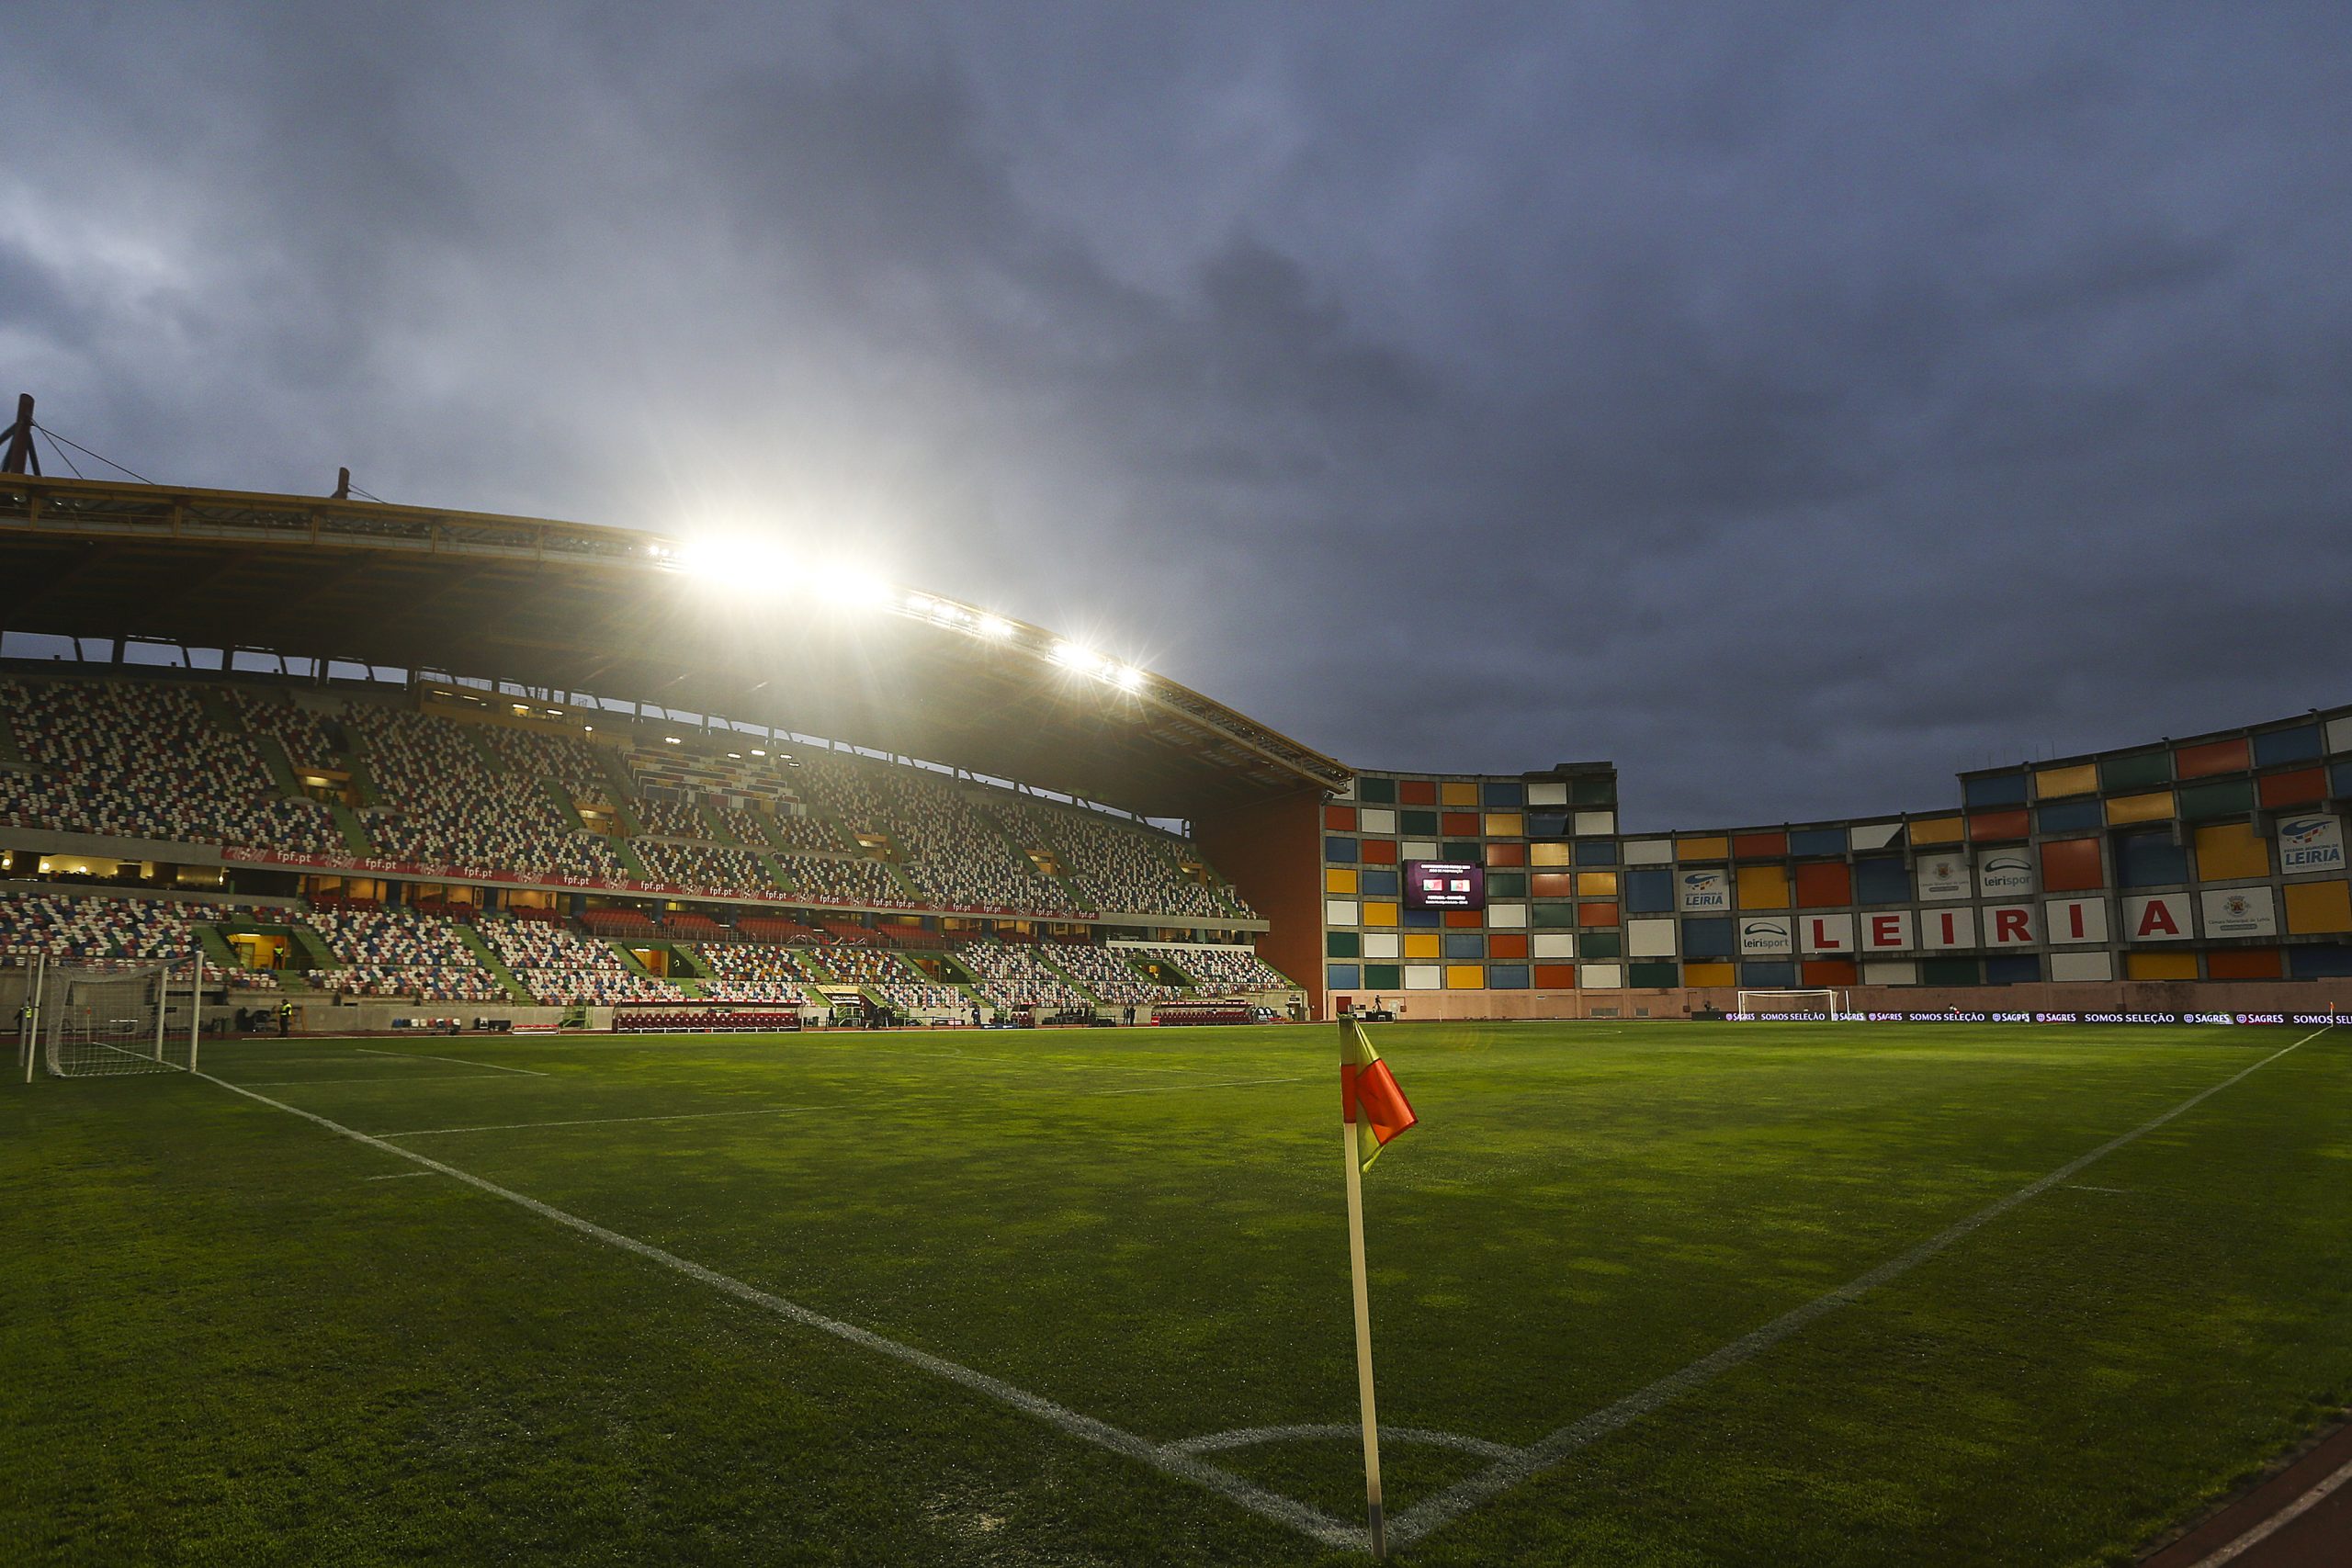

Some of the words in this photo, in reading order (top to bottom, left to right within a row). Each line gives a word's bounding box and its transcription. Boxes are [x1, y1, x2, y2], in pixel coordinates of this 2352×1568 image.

[277, 850, 312, 863] fpf.pt
[2286, 847, 2340, 865] LEIRIA
[365, 858, 397, 871] fpf.pt
[464, 866, 492, 879] fpf.pt
[563, 874, 590, 886] fpf.pt
[640, 880, 664, 892] fpf.pt
[1984, 875, 2031, 887] leirispor
[709, 886, 732, 897] fpf.pt
[765, 890, 787, 900] fpf.pt
[820, 895, 840, 905] fpf.pt
[873, 897, 893, 908] fpf.pt
[896, 899, 915, 908] fpf.pt
[1685, 896, 1723, 906] LEIRIA
[953, 903, 971, 912] fpf.pt
[983, 904, 1001, 913] fpf.pt
[1813, 899, 2180, 949] LEIRIA
[1744, 938, 1789, 950] leirisport
[1909, 1013, 1942, 1021] SOMOS
[1943, 1011, 1985, 1022] SELEÇÃO
[2046, 1012, 2076, 1022] SAGRES
[2085, 1013, 2123, 1022] SOMOS
[2125, 1012, 2175, 1024] SELEÇÃO
[2195, 1013, 2230, 1023] SAGRES
[2248, 1013, 2284, 1023] SAGRES
[2293, 1015, 2333, 1024] SOMOS
